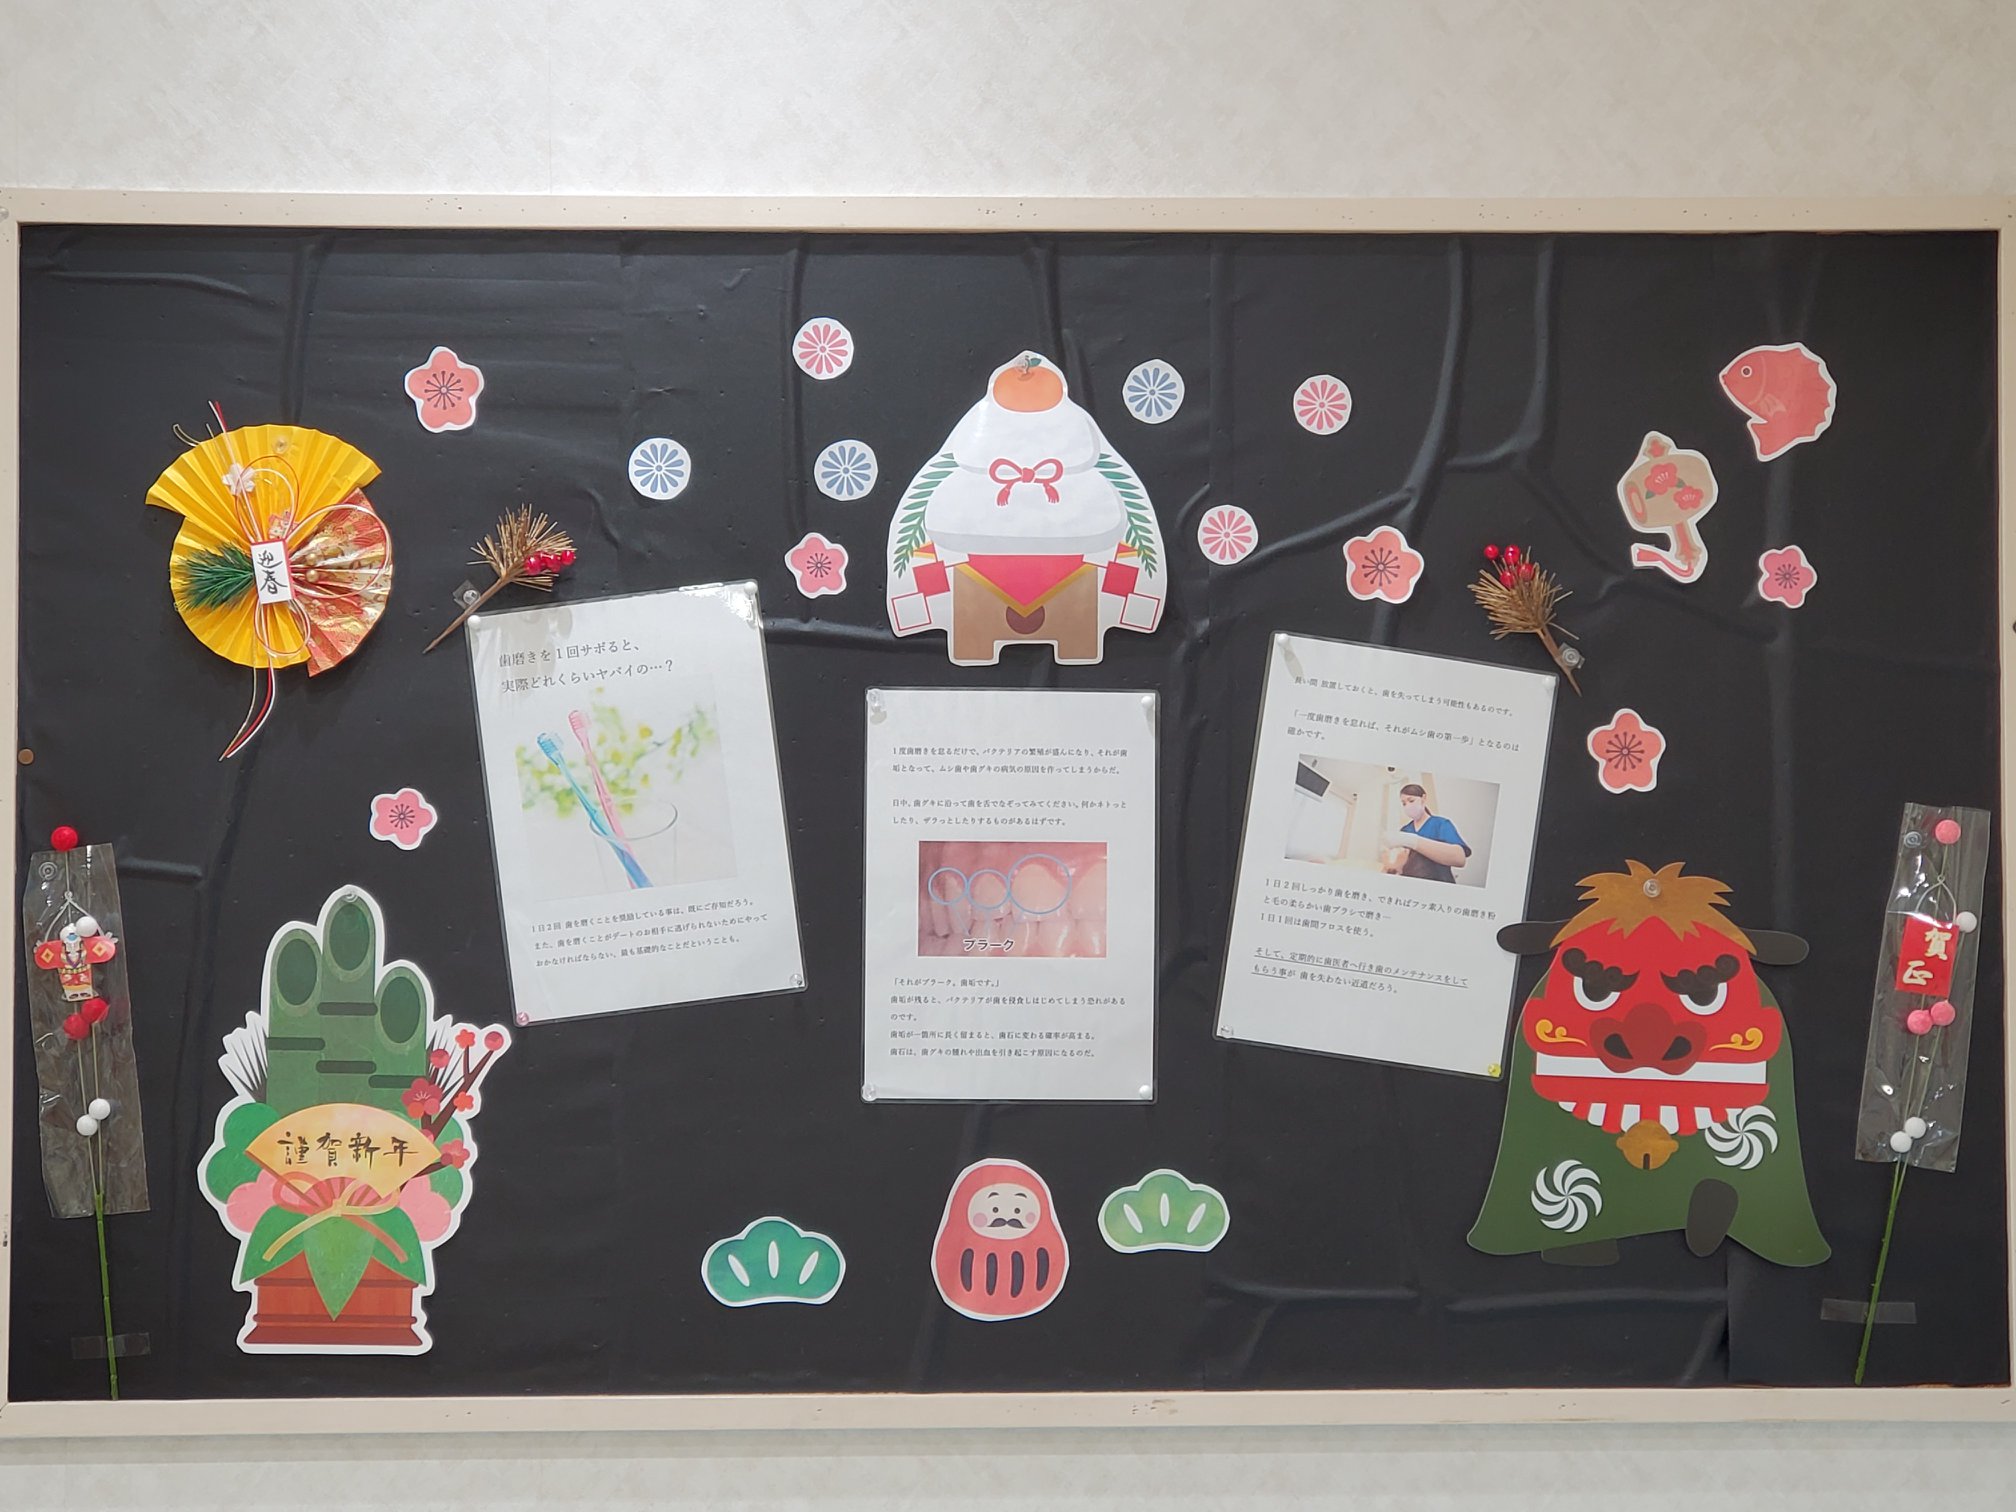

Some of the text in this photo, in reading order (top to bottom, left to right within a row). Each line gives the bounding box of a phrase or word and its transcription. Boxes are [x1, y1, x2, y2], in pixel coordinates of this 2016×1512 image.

[257, 550, 288, 594] 迎春
[499, 639, 640, 668] 歯磨きを1回サボると、
[1287, 726, 1325, 741] 確かです。
[1902, 927, 1952, 986] 賀正
[890, 1013, 918, 1022] のです。
[277, 1131, 419, 1169] 謹賀新年
